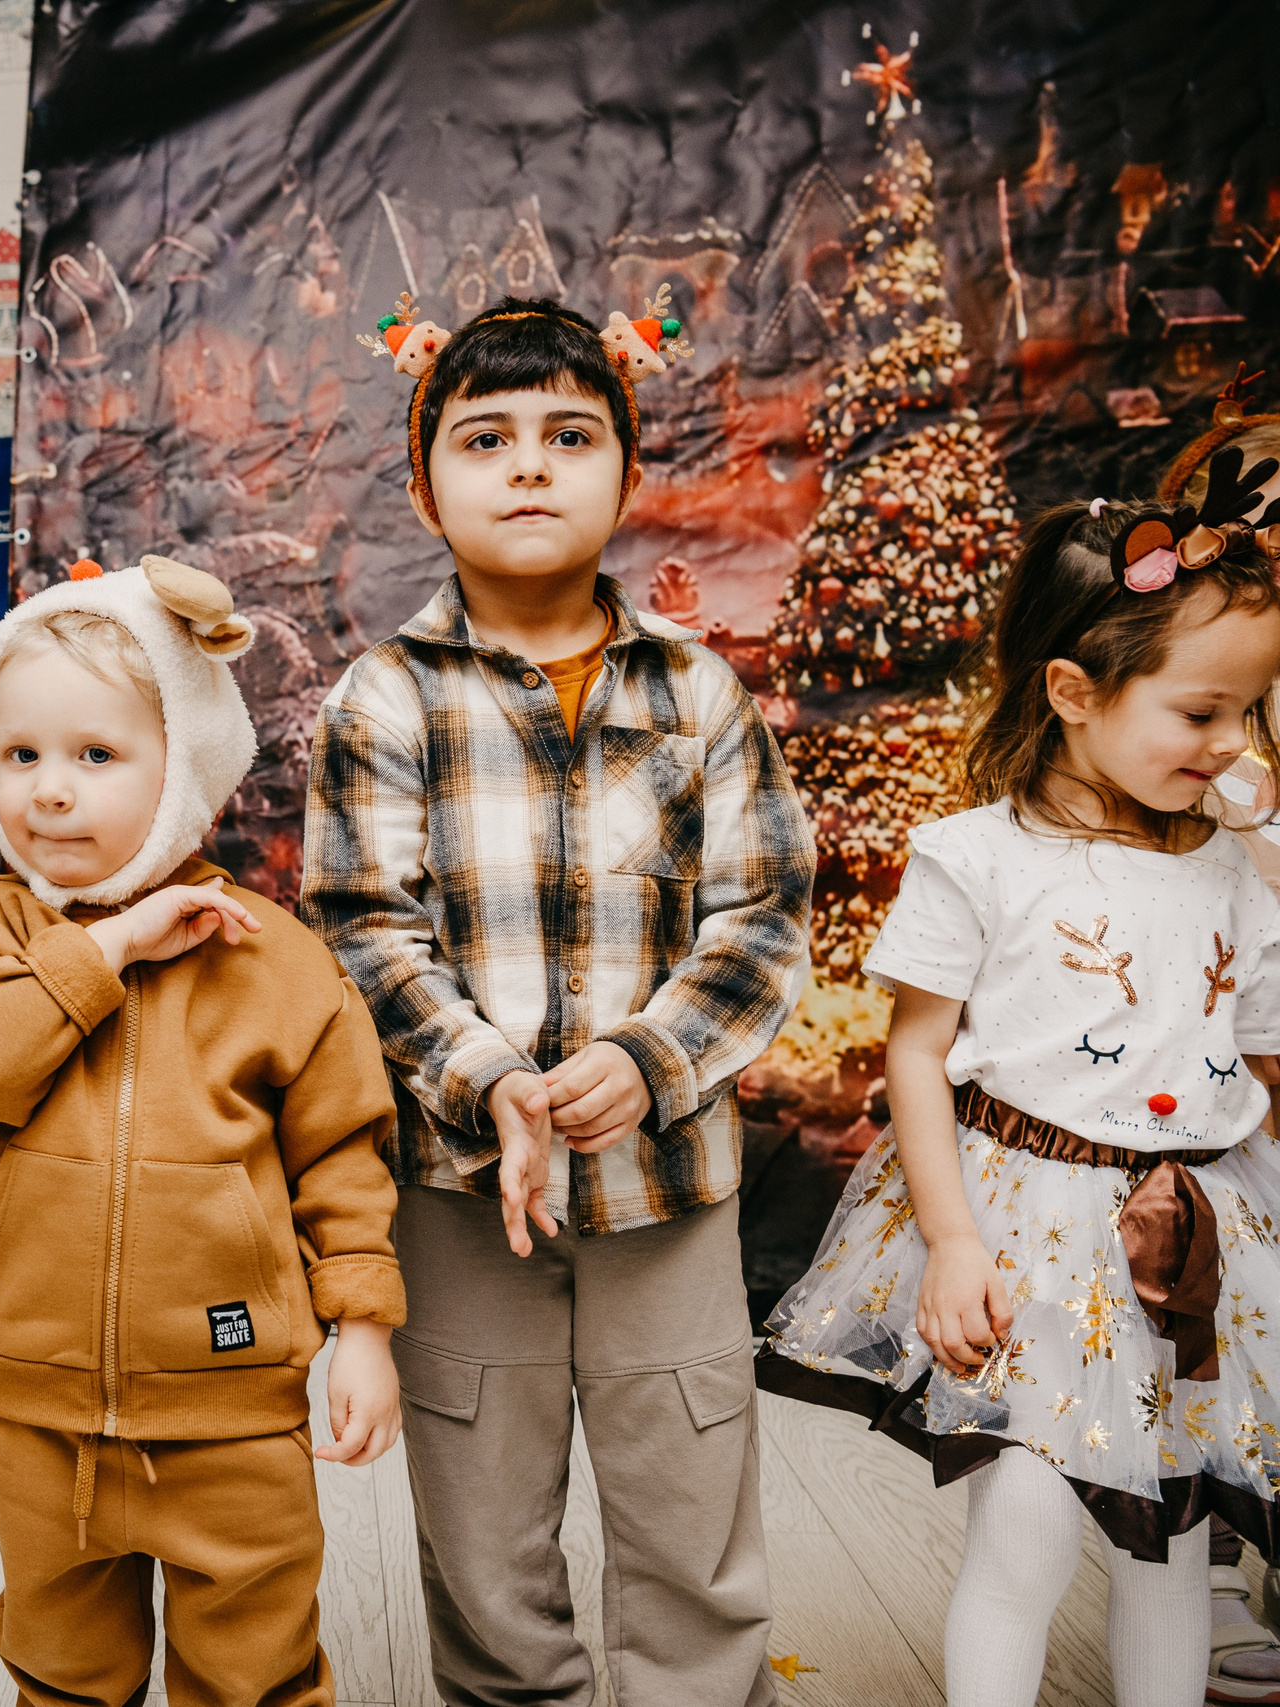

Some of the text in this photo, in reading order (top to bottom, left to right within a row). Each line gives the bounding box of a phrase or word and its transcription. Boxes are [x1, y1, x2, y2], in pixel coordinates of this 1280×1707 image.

[1100, 1110, 1209, 1141] Merry Christmas!
[215, 1318, 249, 1334] JUST FOR
[216, 1328, 251, 1347] SKATE
